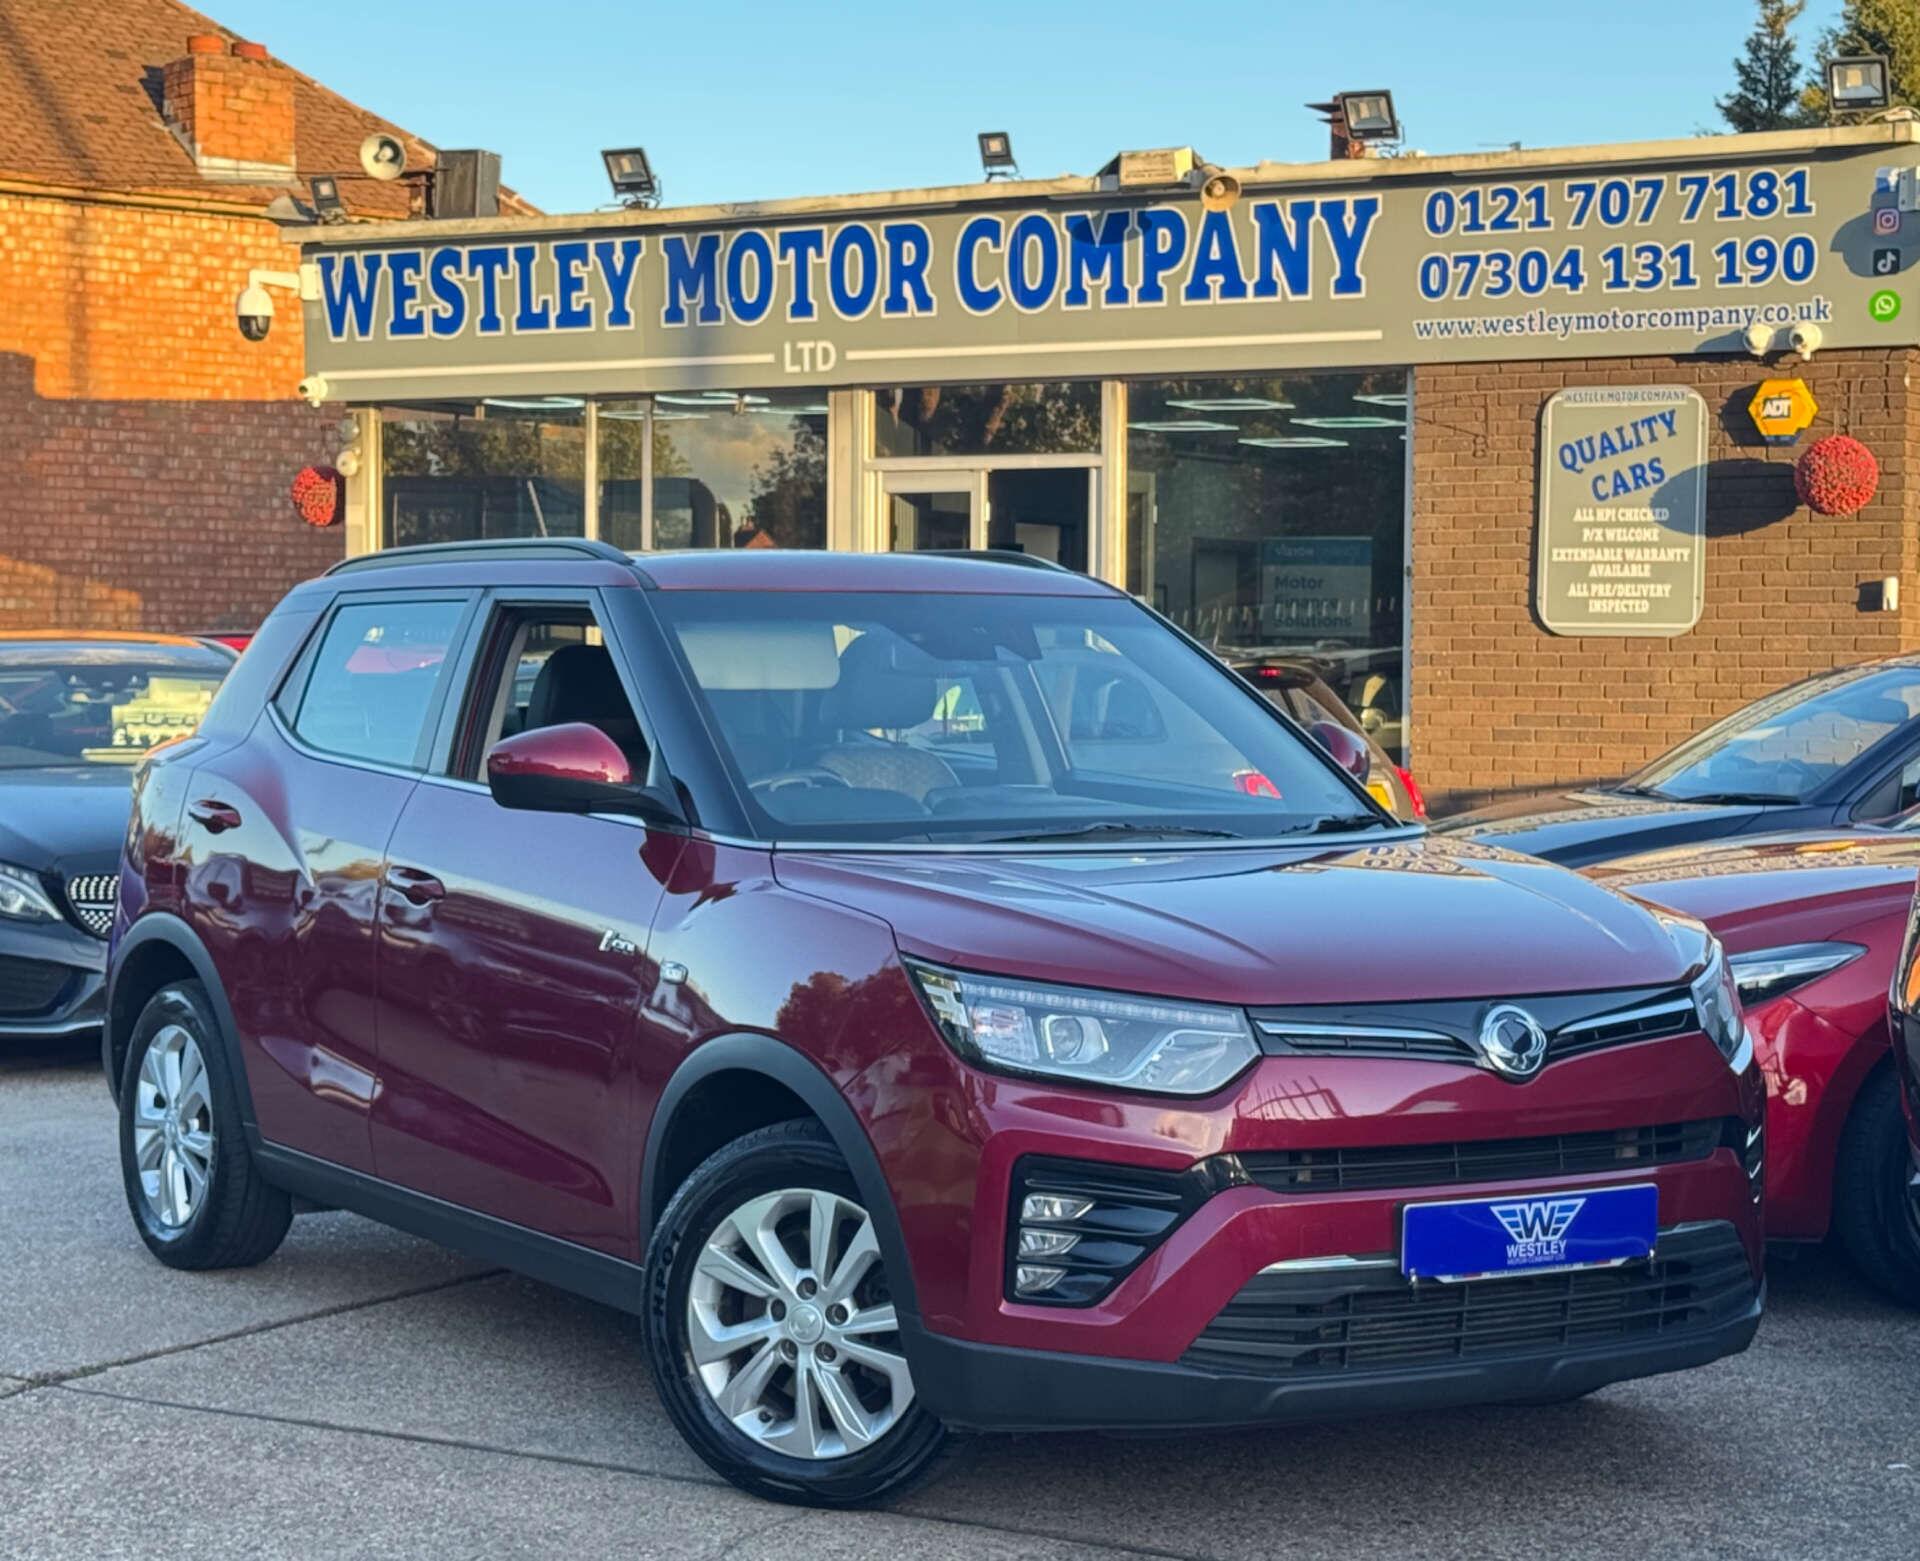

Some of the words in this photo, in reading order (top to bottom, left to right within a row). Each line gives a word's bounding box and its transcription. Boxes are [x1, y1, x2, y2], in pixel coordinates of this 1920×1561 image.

[1423, 186, 1553, 238] 0121
[1566, 175, 1667, 230] 707
[1679, 167, 1815, 224] 7181
[314, 236, 646, 343] WESTLEY
[659, 219, 938, 328] MOTOR
[955, 194, 1383, 317] COMPANY
[1418, 246, 1587, 301] 07304
[1600, 240, 1699, 293] 131
[1713, 234, 1818, 287] 190
[1414, 297, 1831, 338] www.westleymotorcompany.co.uk
[782, 340, 837, 374] LTD
[1607, 390, 1639, 401] MOTOR
[1641, 389, 1686, 400] COMPANY
[1763, 399, 1792, 417] ADT
[1558, 408, 1678, 474] QUALITY
[1591, 456, 1666, 502] CARS
[1573, 508, 1595, 522] ALL
[1617, 508, 1670, 521] CHECKED
[1605, 527, 1660, 541] WELCOME
[1551, 547, 1624, 562] EXTENDABLE
[1624, 547, 1691, 562] WARRANTY
[1588, 563, 1652, 577] AVAILABLE
[1274, 575, 1324, 590] Motor
[1567, 583, 1589, 597] ALL
[1590, 583, 1672, 597] PRE/DELIVERY
[1588, 598, 1650, 613] INSPECTED
[1506, 1239, 1567, 1258] WESTLEY
